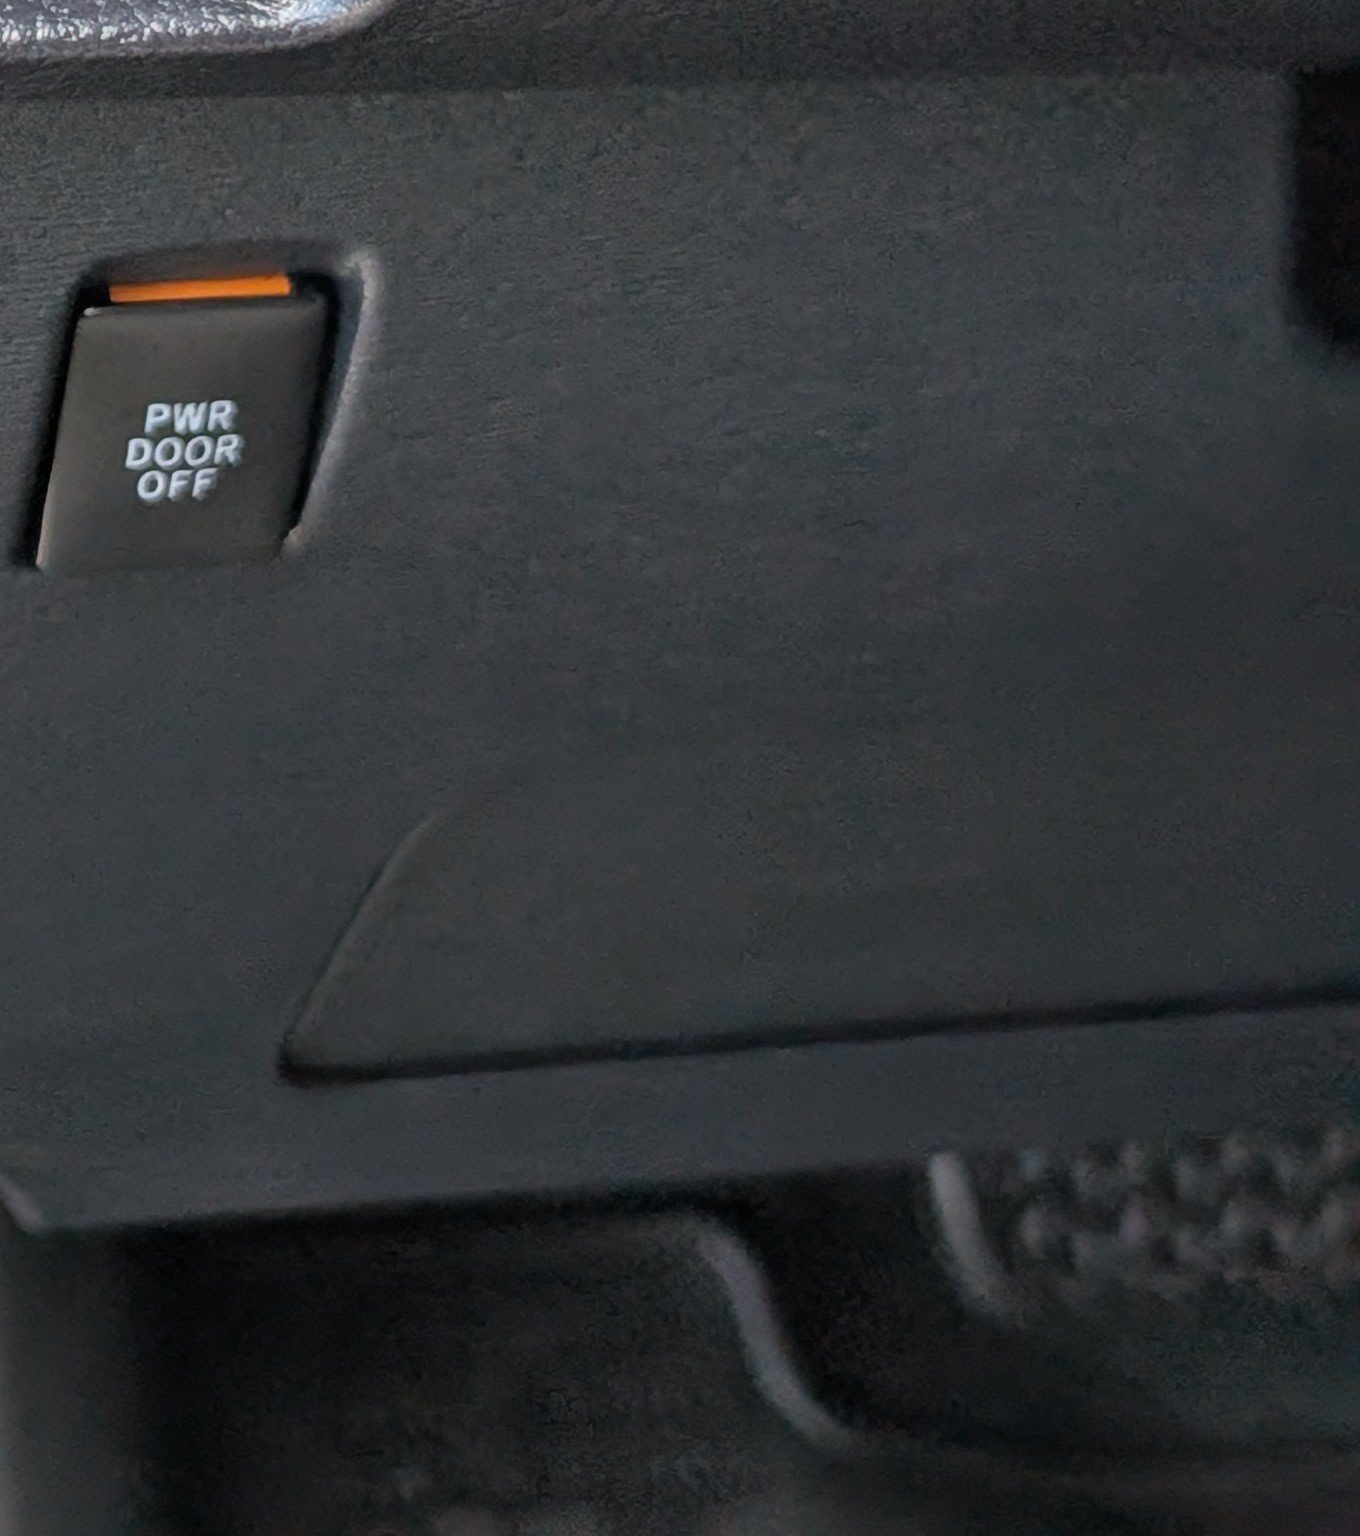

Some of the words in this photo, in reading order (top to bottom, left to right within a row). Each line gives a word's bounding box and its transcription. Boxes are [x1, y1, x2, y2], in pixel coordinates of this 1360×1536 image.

[144, 399, 237, 434] PWR
[125, 434, 244, 470] DOOR
[137, 467, 219, 503] OFF
